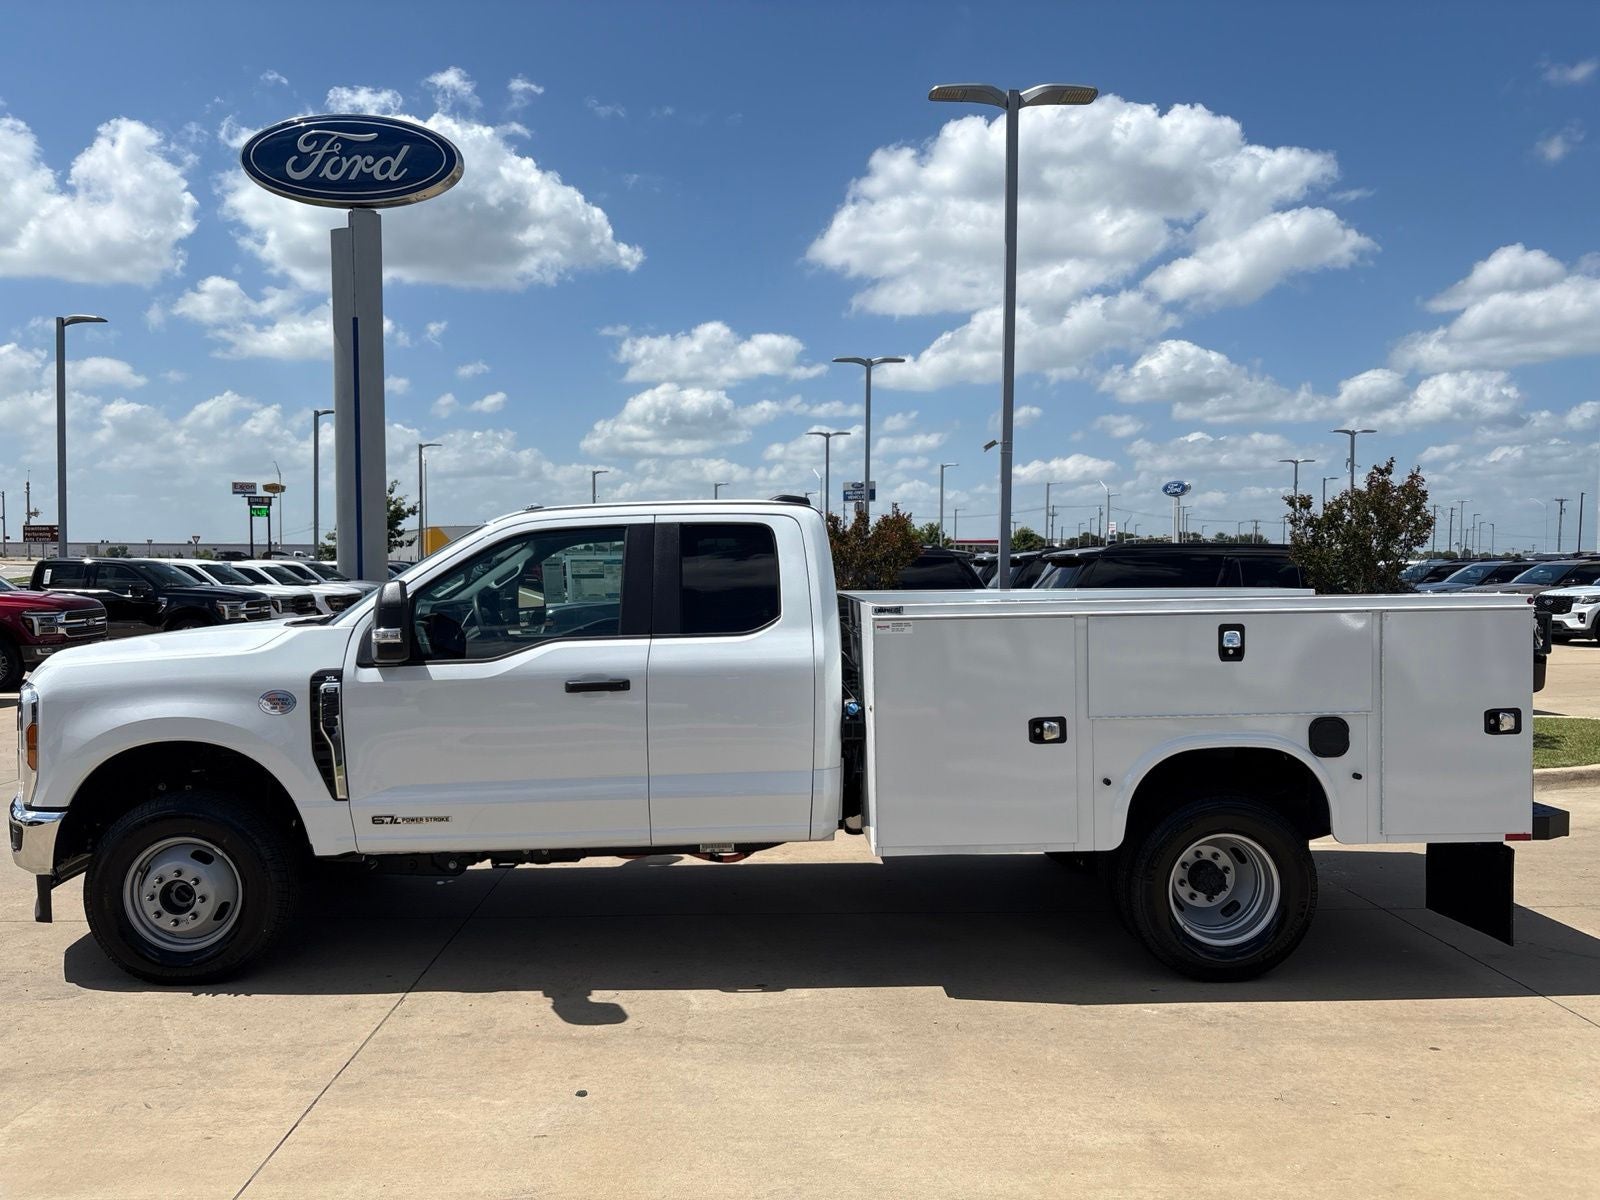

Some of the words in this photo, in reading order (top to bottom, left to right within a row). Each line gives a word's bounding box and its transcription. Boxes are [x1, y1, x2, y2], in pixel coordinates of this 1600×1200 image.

[285, 129, 410, 181] Ford
[234, 482, 255, 490] Exxon
[371, 815, 401, 825] 6.7L
